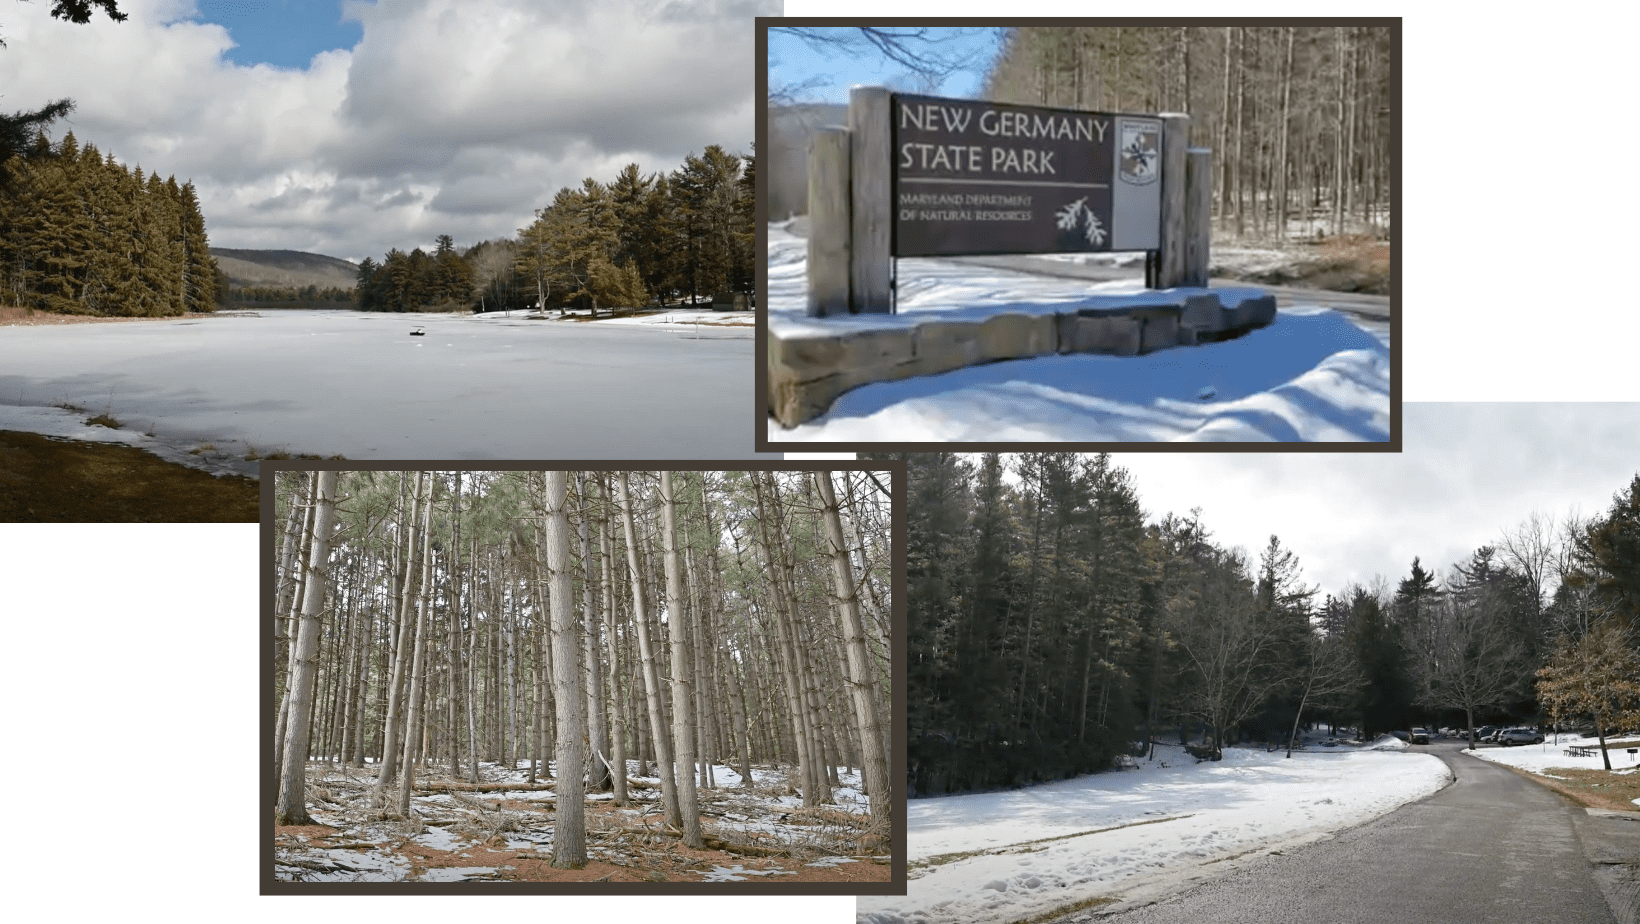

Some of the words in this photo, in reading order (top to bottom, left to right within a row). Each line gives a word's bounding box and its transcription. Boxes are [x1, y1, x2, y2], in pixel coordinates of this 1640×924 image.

[900, 104, 972, 133] NEW
[979, 110, 1109, 143] GERMANY
[900, 142, 982, 172] STATE
[991, 147, 1056, 175] PARK
[899, 193, 963, 206] MARYLAND
[965, 194, 1032, 207] DEPARTMENT
[900, 209, 917, 221] OF
[920, 209, 972, 221] NATURAL
[975, 210, 1032, 221] RESOURCES
